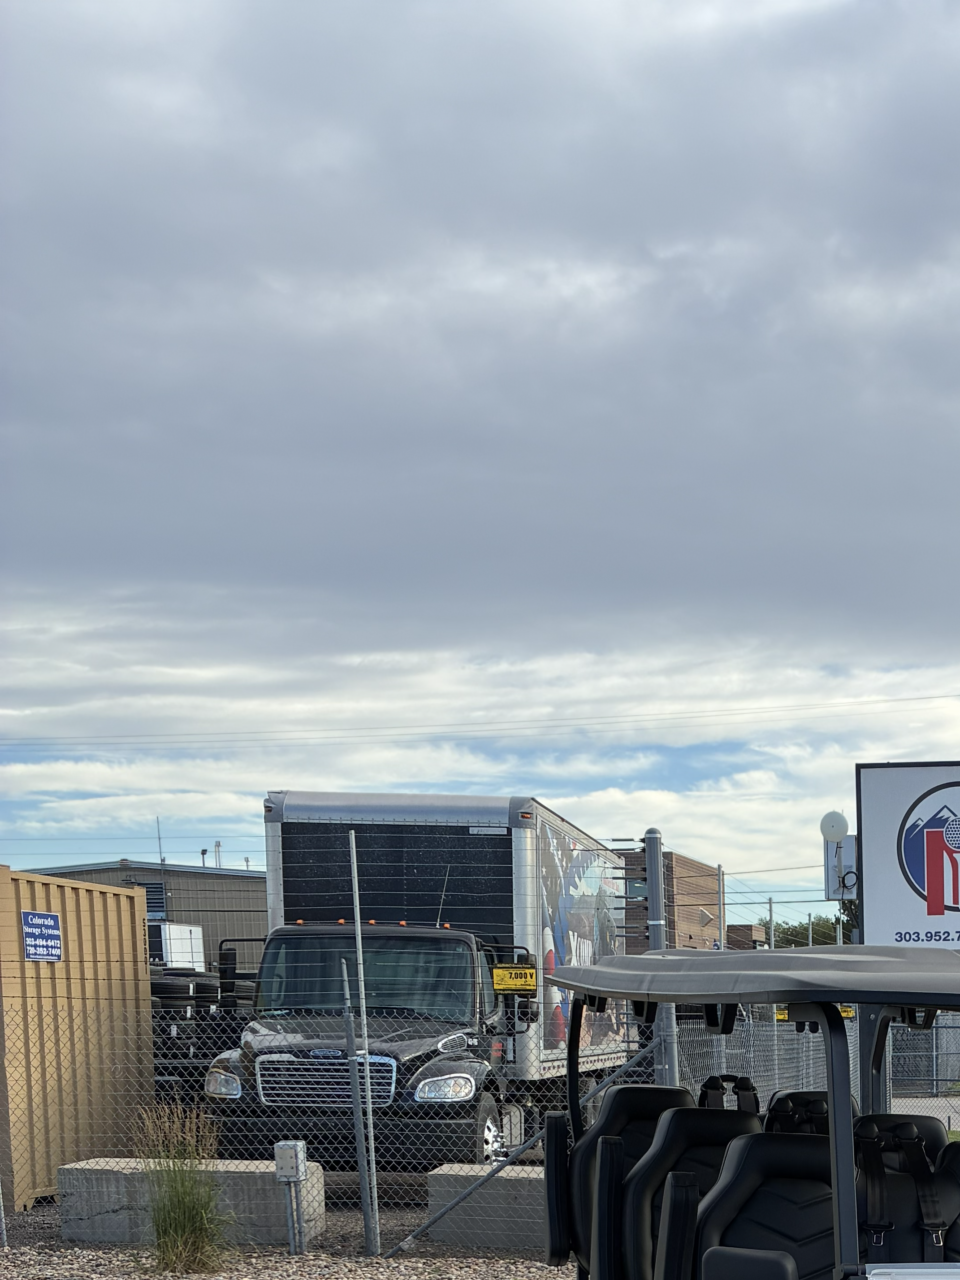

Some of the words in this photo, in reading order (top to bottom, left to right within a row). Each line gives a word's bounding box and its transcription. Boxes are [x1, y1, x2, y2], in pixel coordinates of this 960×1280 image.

[28, 915, 54, 926] Colorado
[24, 926, 41, 936] Storage
[42, 927, 60, 936] Systems
[508, 972, 528, 980] 7,000
